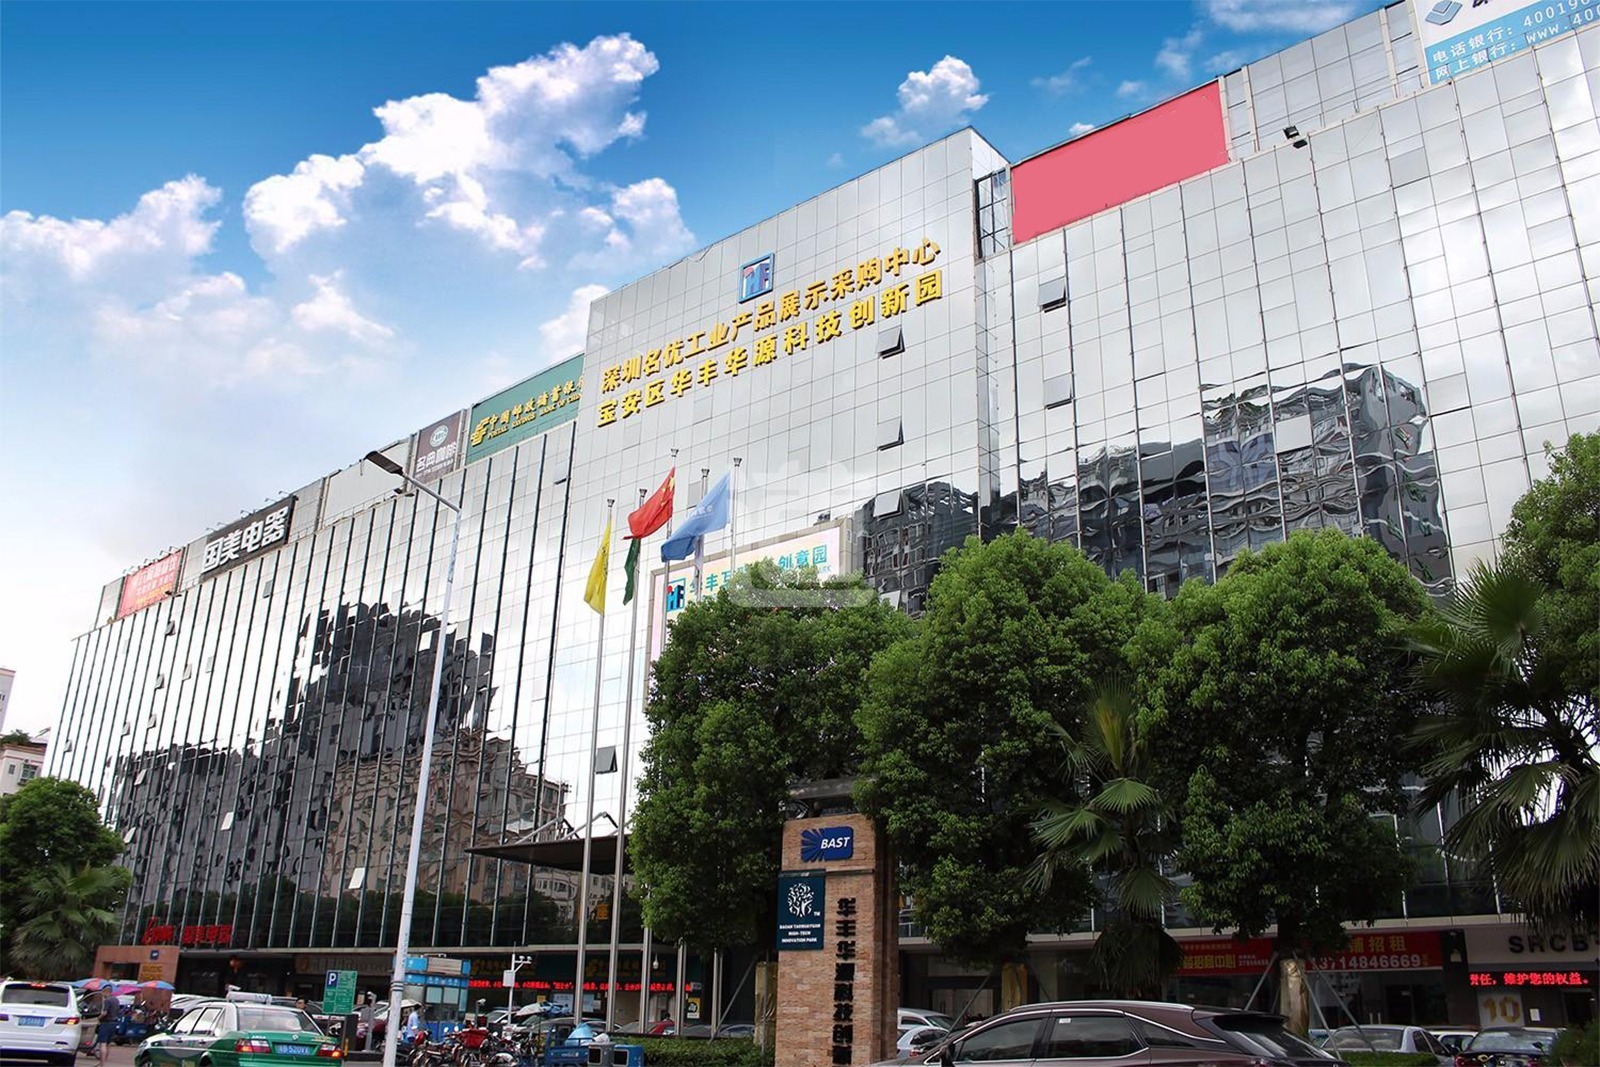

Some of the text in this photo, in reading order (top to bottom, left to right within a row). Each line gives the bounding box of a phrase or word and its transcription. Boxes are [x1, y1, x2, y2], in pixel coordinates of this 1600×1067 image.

[597, 270, 943, 427] 宝安区华丰华源科技创新园
[601, 237, 941, 395] 深圳名优工业产品展示采购中心
[201, 506, 289, 573] 国美电器
[820, 836, 851, 849] BAST
[1483, 995, 1520, 1023] 10
